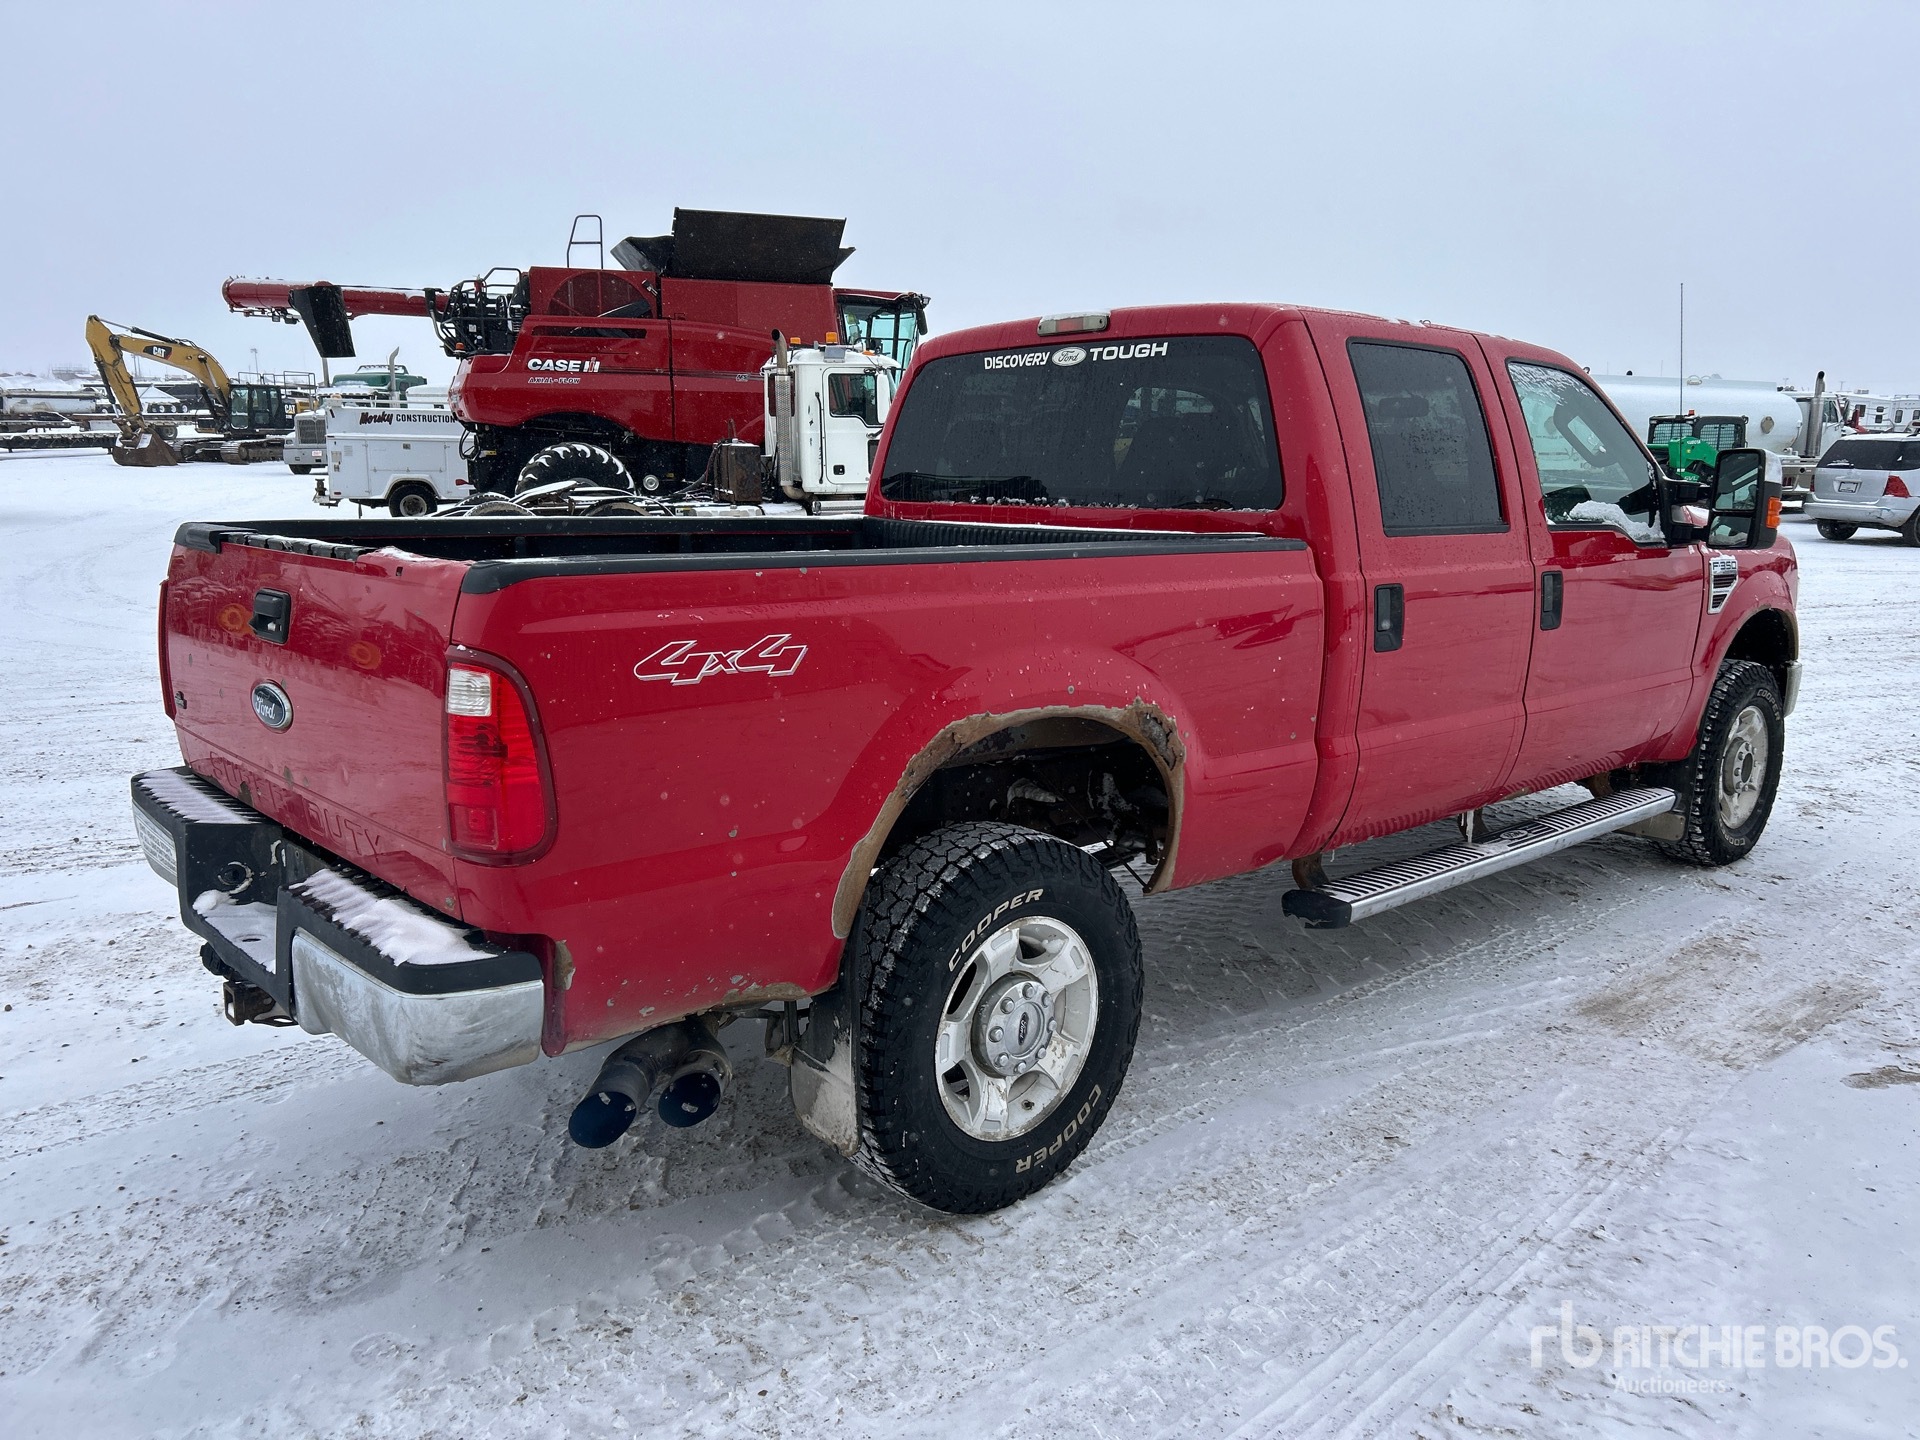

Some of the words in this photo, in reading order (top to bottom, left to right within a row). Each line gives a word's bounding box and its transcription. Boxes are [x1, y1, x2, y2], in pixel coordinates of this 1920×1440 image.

[152, 346, 166, 358] CAT
[527, 358, 582, 372] CASE
[984, 352, 1050, 370] DISCOVERY
[1089, 342, 1169, 362] TOUGH
[284, 404, 296, 415] CAT
[395, 413, 456, 424] CONSTRUCTION
[633, 633, 809, 687] 4x4
[255, 691, 277, 720] Ford
[301, 797, 381, 866] DUTY
[948, 888, 1044, 972] COOPER
[1015, 1084, 1102, 1174] COOPER
